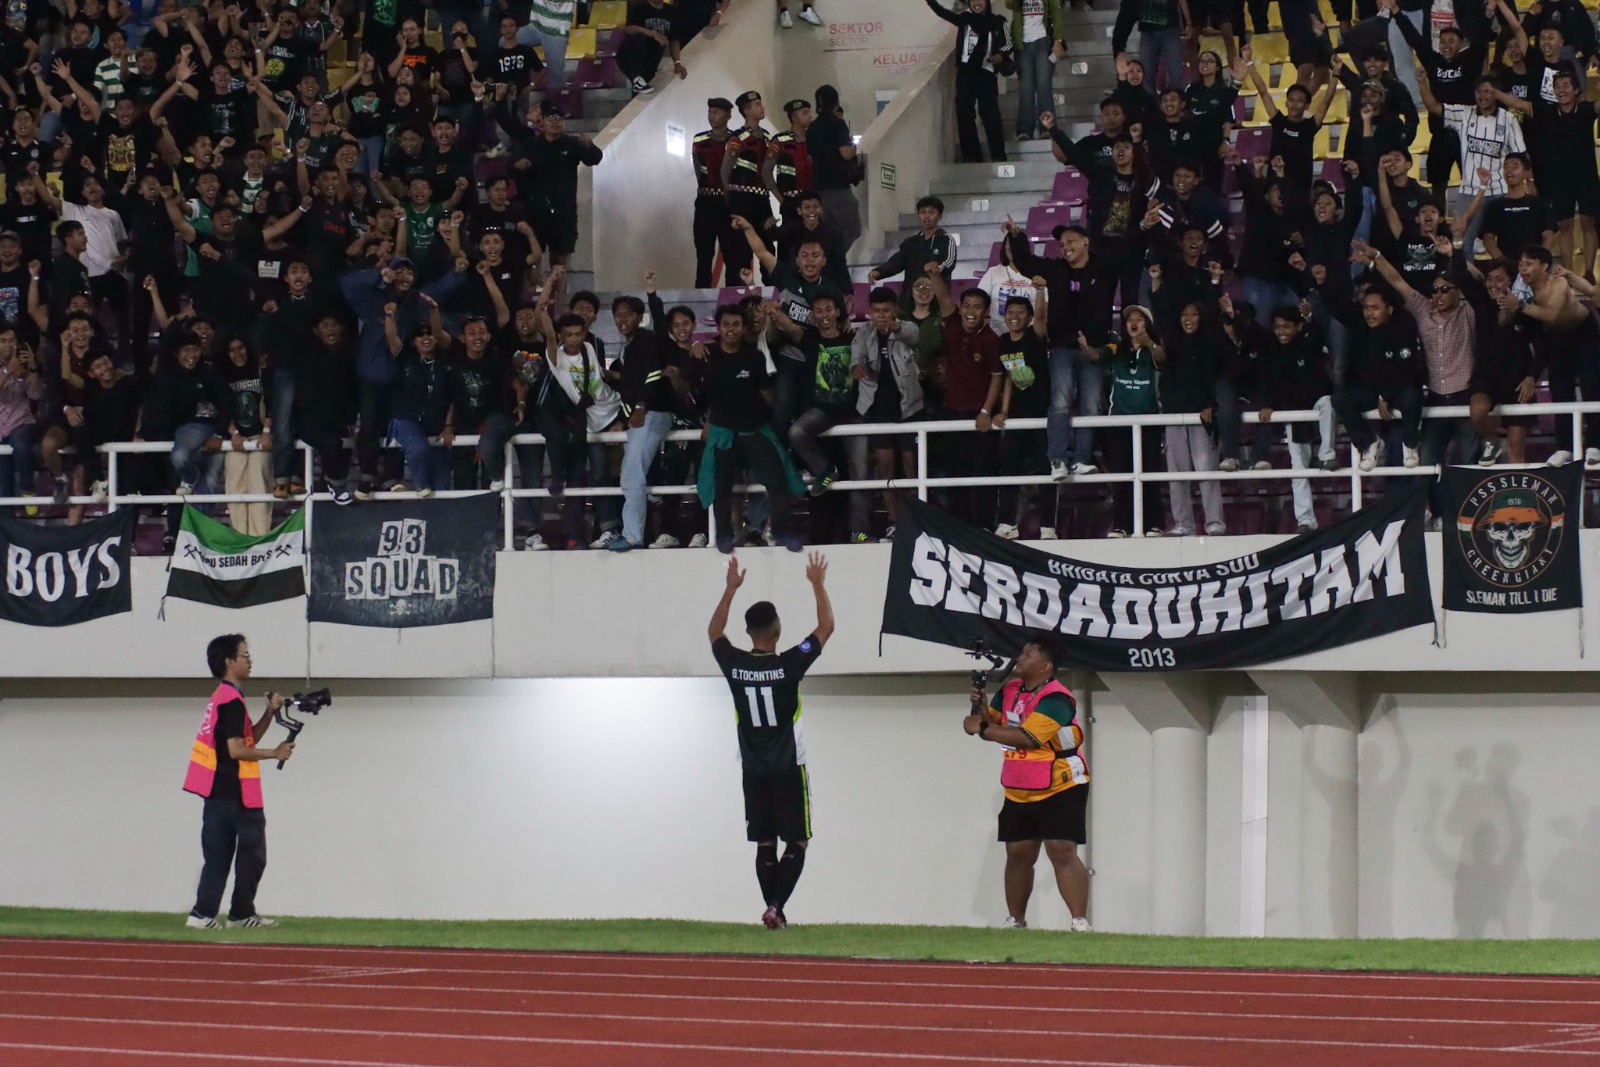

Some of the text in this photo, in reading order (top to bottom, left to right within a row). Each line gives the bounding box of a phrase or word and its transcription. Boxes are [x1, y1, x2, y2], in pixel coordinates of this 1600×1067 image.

[829, 22, 883, 34] SEKTOR
[829, 36, 868, 46] SECTOR
[382, 523, 423, 554] 93
[6, 536, 122, 602] BOYS
[218, 556, 248, 568] SEDAH
[1048, 558, 1134, 586] BRIGATA
[347, 560, 456, 598] SQUAD
[1466, 590, 1506, 607] SLEMAN
[1508, 590, 1532, 605] TILL
[1541, 588, 1558, 601] DIE
[1128, 647, 1176, 668] 2013
[744, 686, 778, 728] 11
